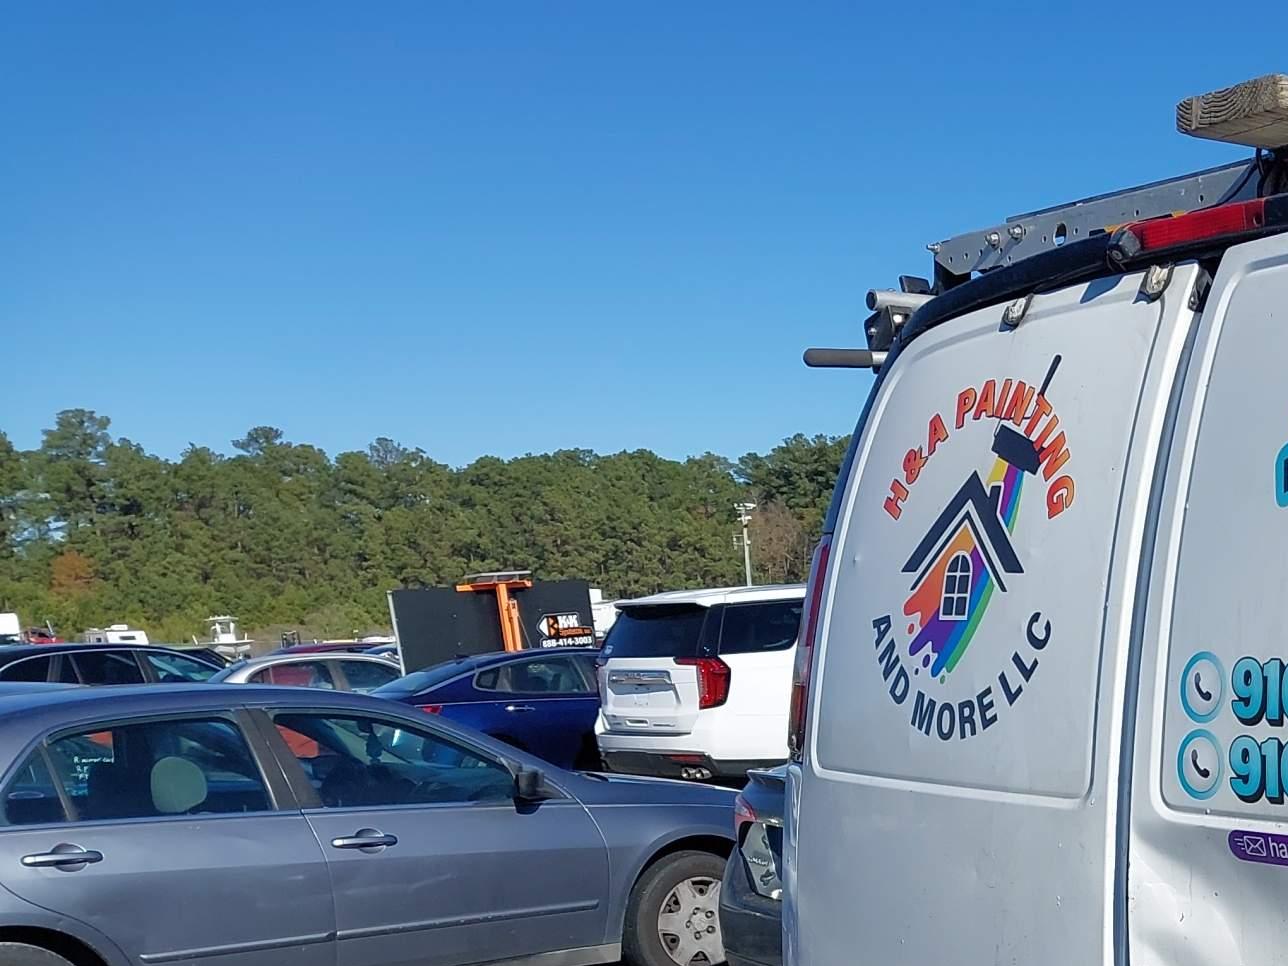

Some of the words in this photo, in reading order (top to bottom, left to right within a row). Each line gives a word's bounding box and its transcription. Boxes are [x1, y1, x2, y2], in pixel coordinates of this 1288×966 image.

[884, 413, 950, 521] H&A
[955, 378, 1076, 520] PAINTING
[872, 614, 911, 705] AND
[911, 686, 998, 742] MORE
[998, 610, 1052, 707] LLC
